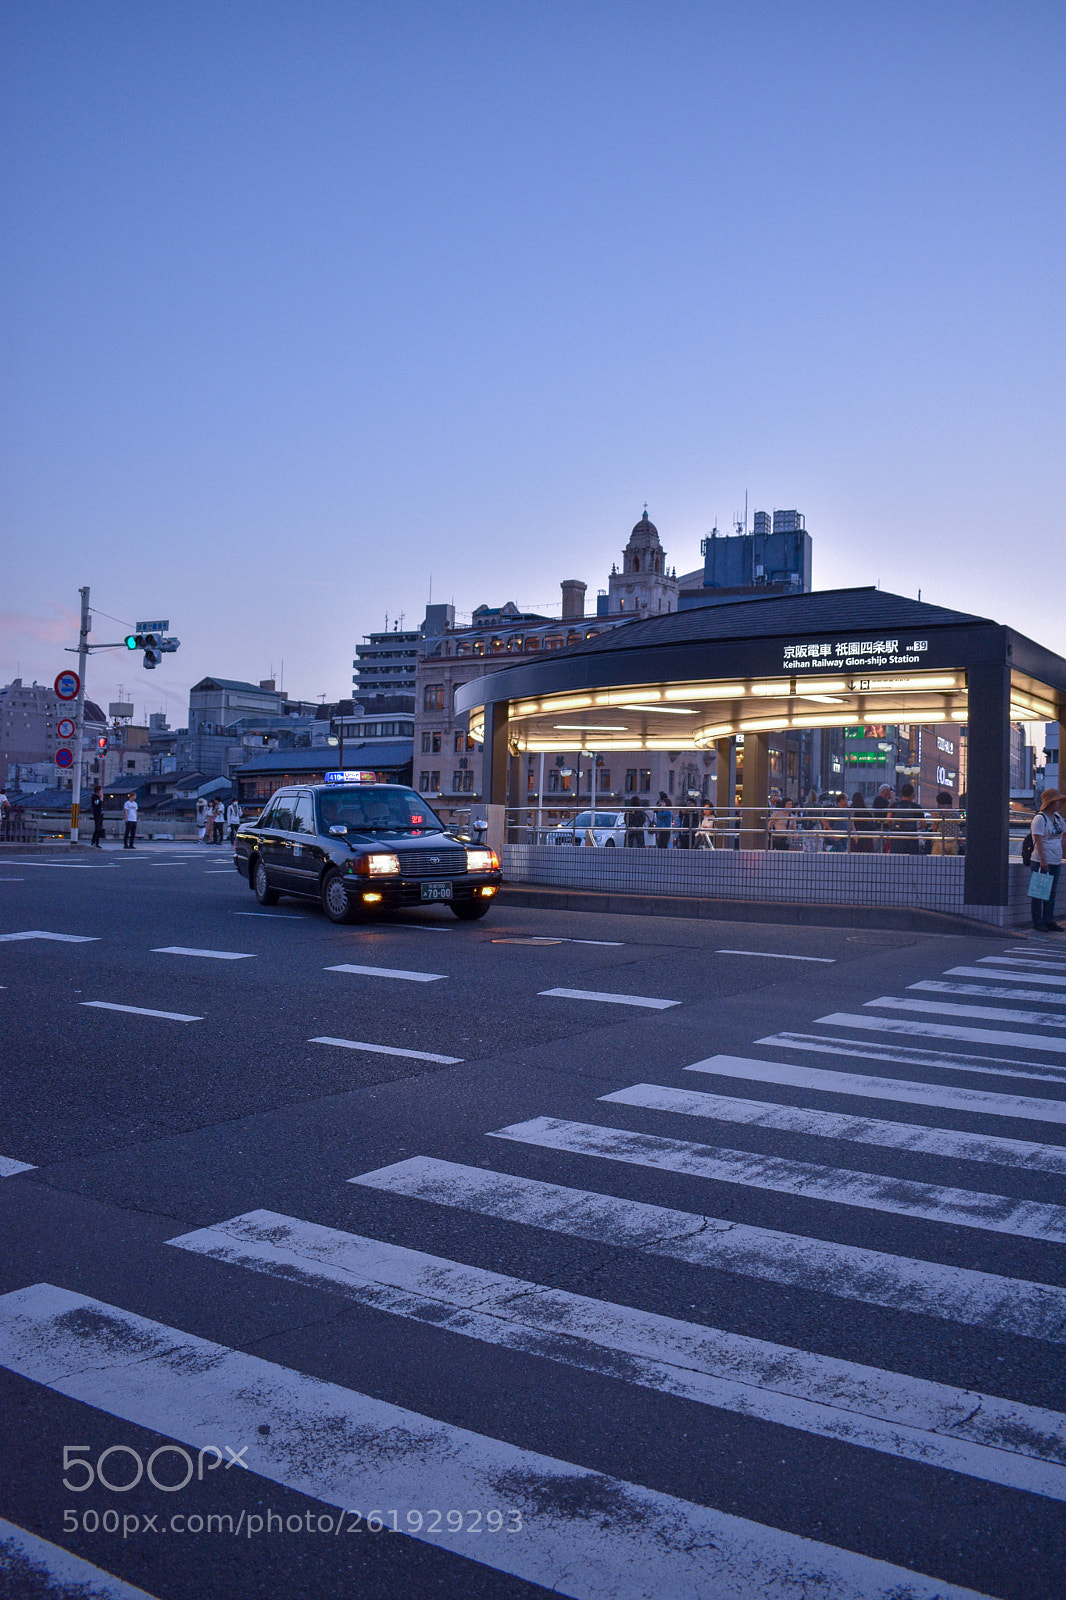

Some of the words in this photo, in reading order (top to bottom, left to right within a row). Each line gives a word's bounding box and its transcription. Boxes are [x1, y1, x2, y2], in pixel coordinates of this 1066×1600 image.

[783, 643, 832, 658] 京阪電車
[835, 640, 899, 656] 祇園四条駅
[783, 660, 810, 669] Keihan
[812, 658, 844, 668] Railway
[845, 656, 888, 667] Gion-shijo
[889, 654, 920, 664] Station
[428, 888, 451, 899] 70-00
